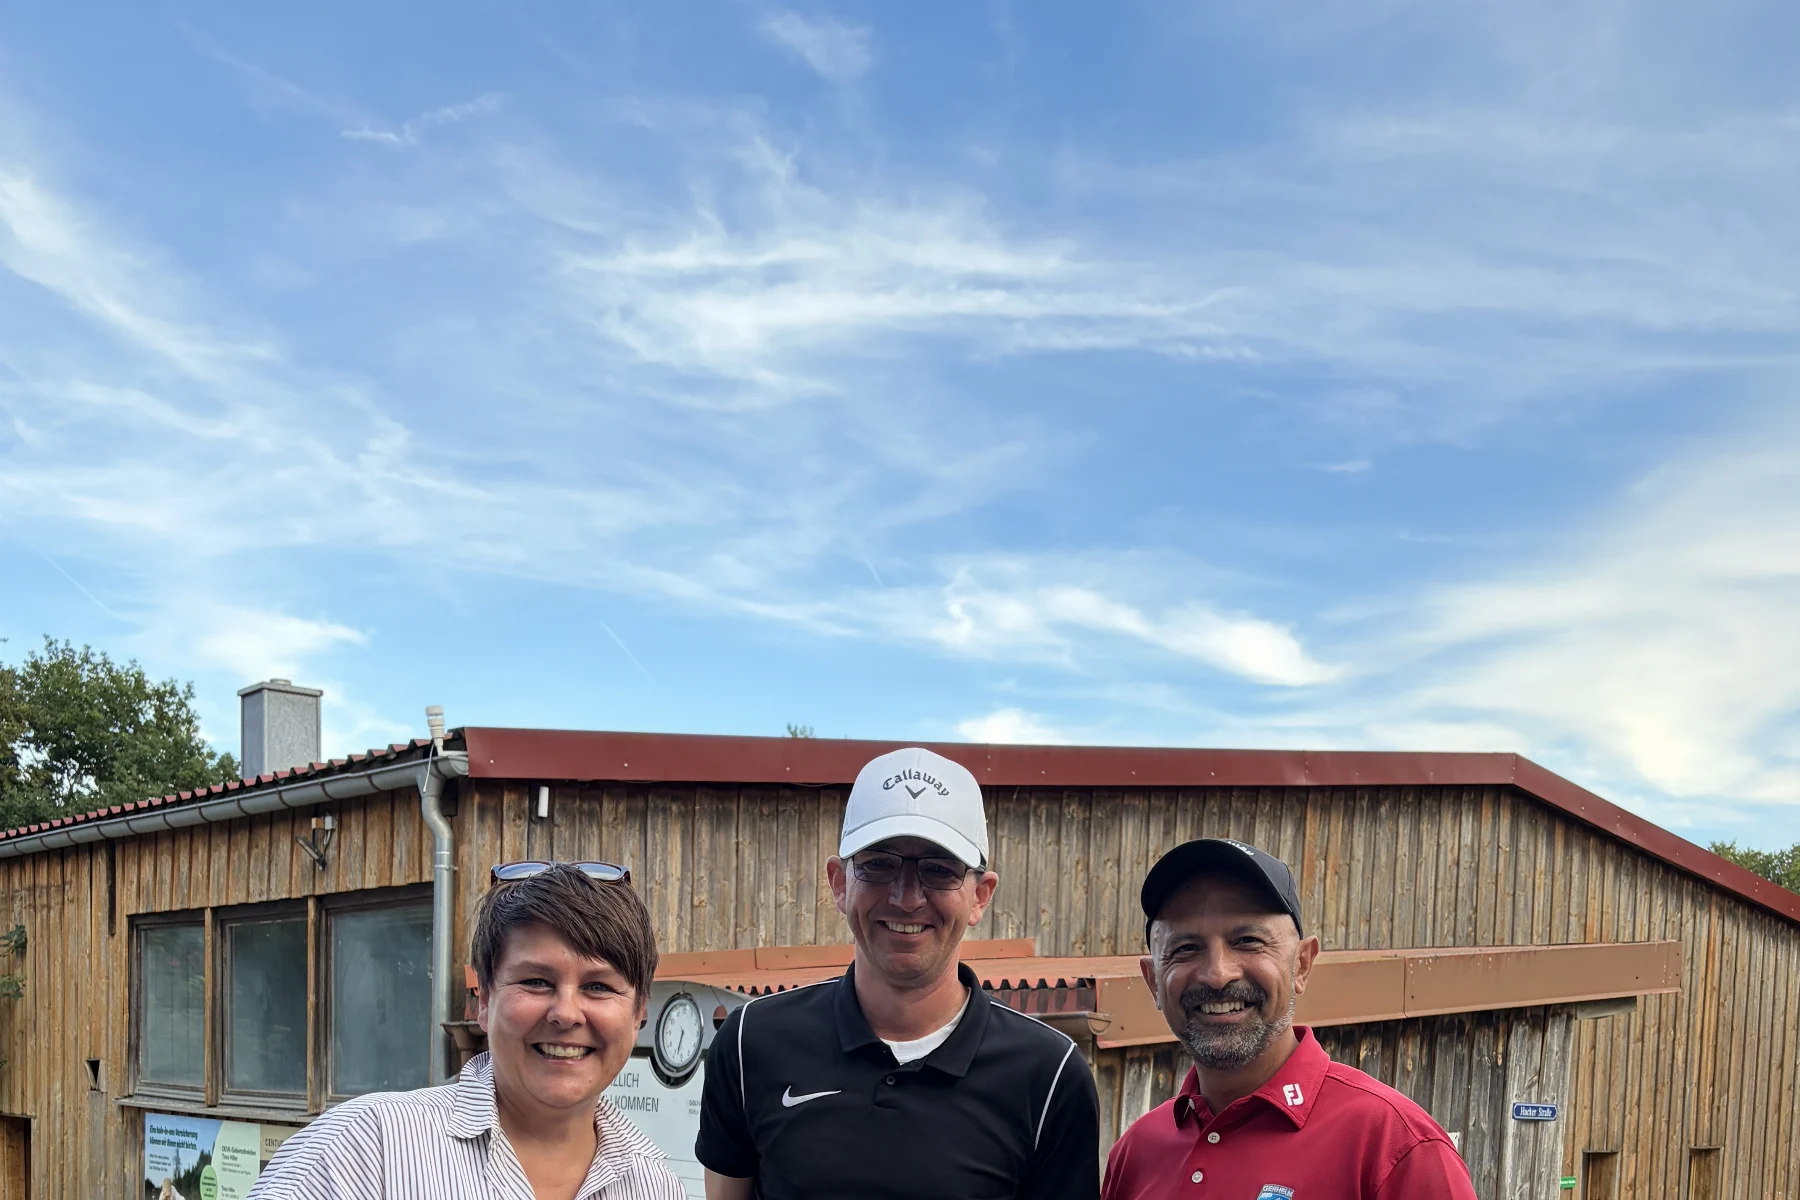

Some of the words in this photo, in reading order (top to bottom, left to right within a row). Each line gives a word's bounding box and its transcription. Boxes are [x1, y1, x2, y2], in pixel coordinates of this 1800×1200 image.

[882, 768, 950, 796] Callaway
[611, 1072, 640, 1088] ZLICH
[605, 1094, 659, 1113] KOMMEN
[1282, 1083, 1304, 1107] FJ
